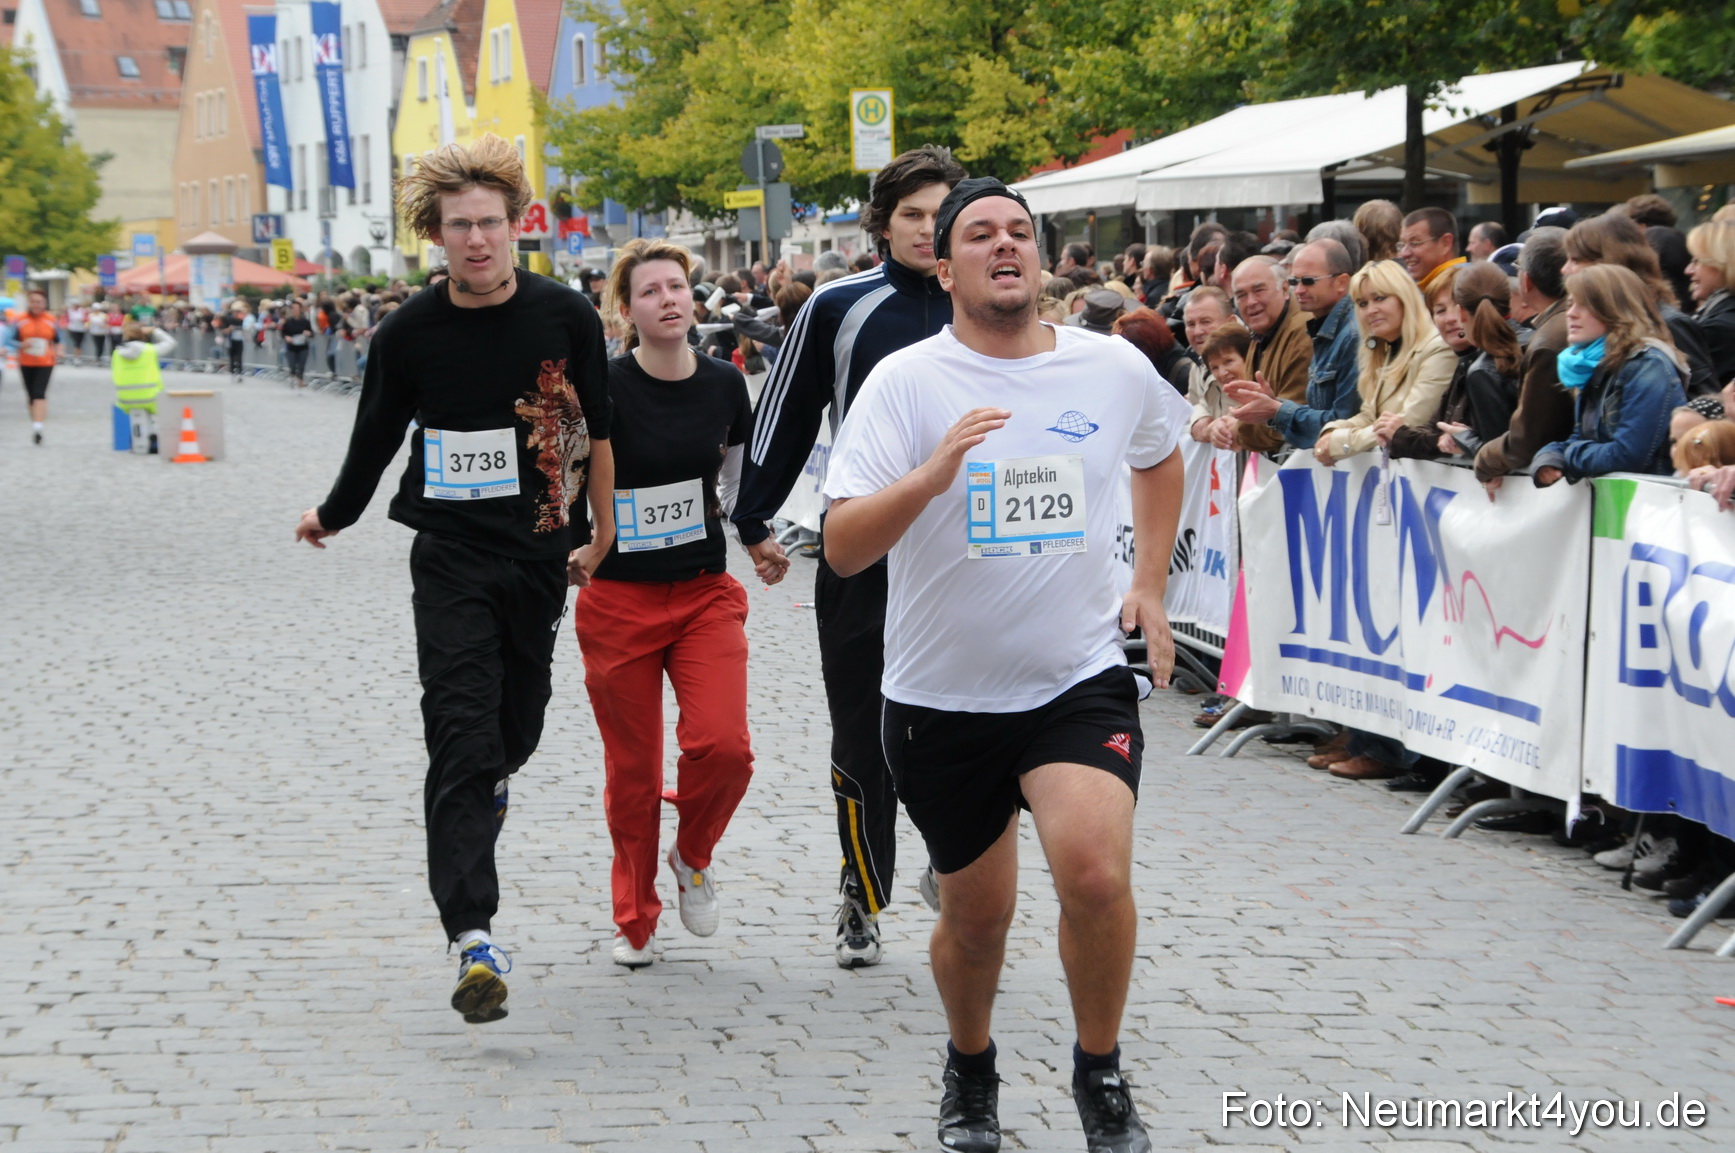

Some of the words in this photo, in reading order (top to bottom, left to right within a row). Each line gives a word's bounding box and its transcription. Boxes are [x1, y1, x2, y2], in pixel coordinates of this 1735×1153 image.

[326, 68, 343, 137] RUPPERT
[278, 248, 289, 264] B
[450, 450, 507, 473] 3738
[480, 483, 518, 494] PFLEIDERER
[1003, 465, 1057, 489] Alptekin
[643, 498, 694, 525] 3737
[977, 497, 985, 511] D
[1005, 493, 1073, 522] 2129
[539, 503, 550, 533] 2008
[673, 528, 704, 541] PFLEIDERER
[1042, 538, 1085, 549] PFLEIDERER
